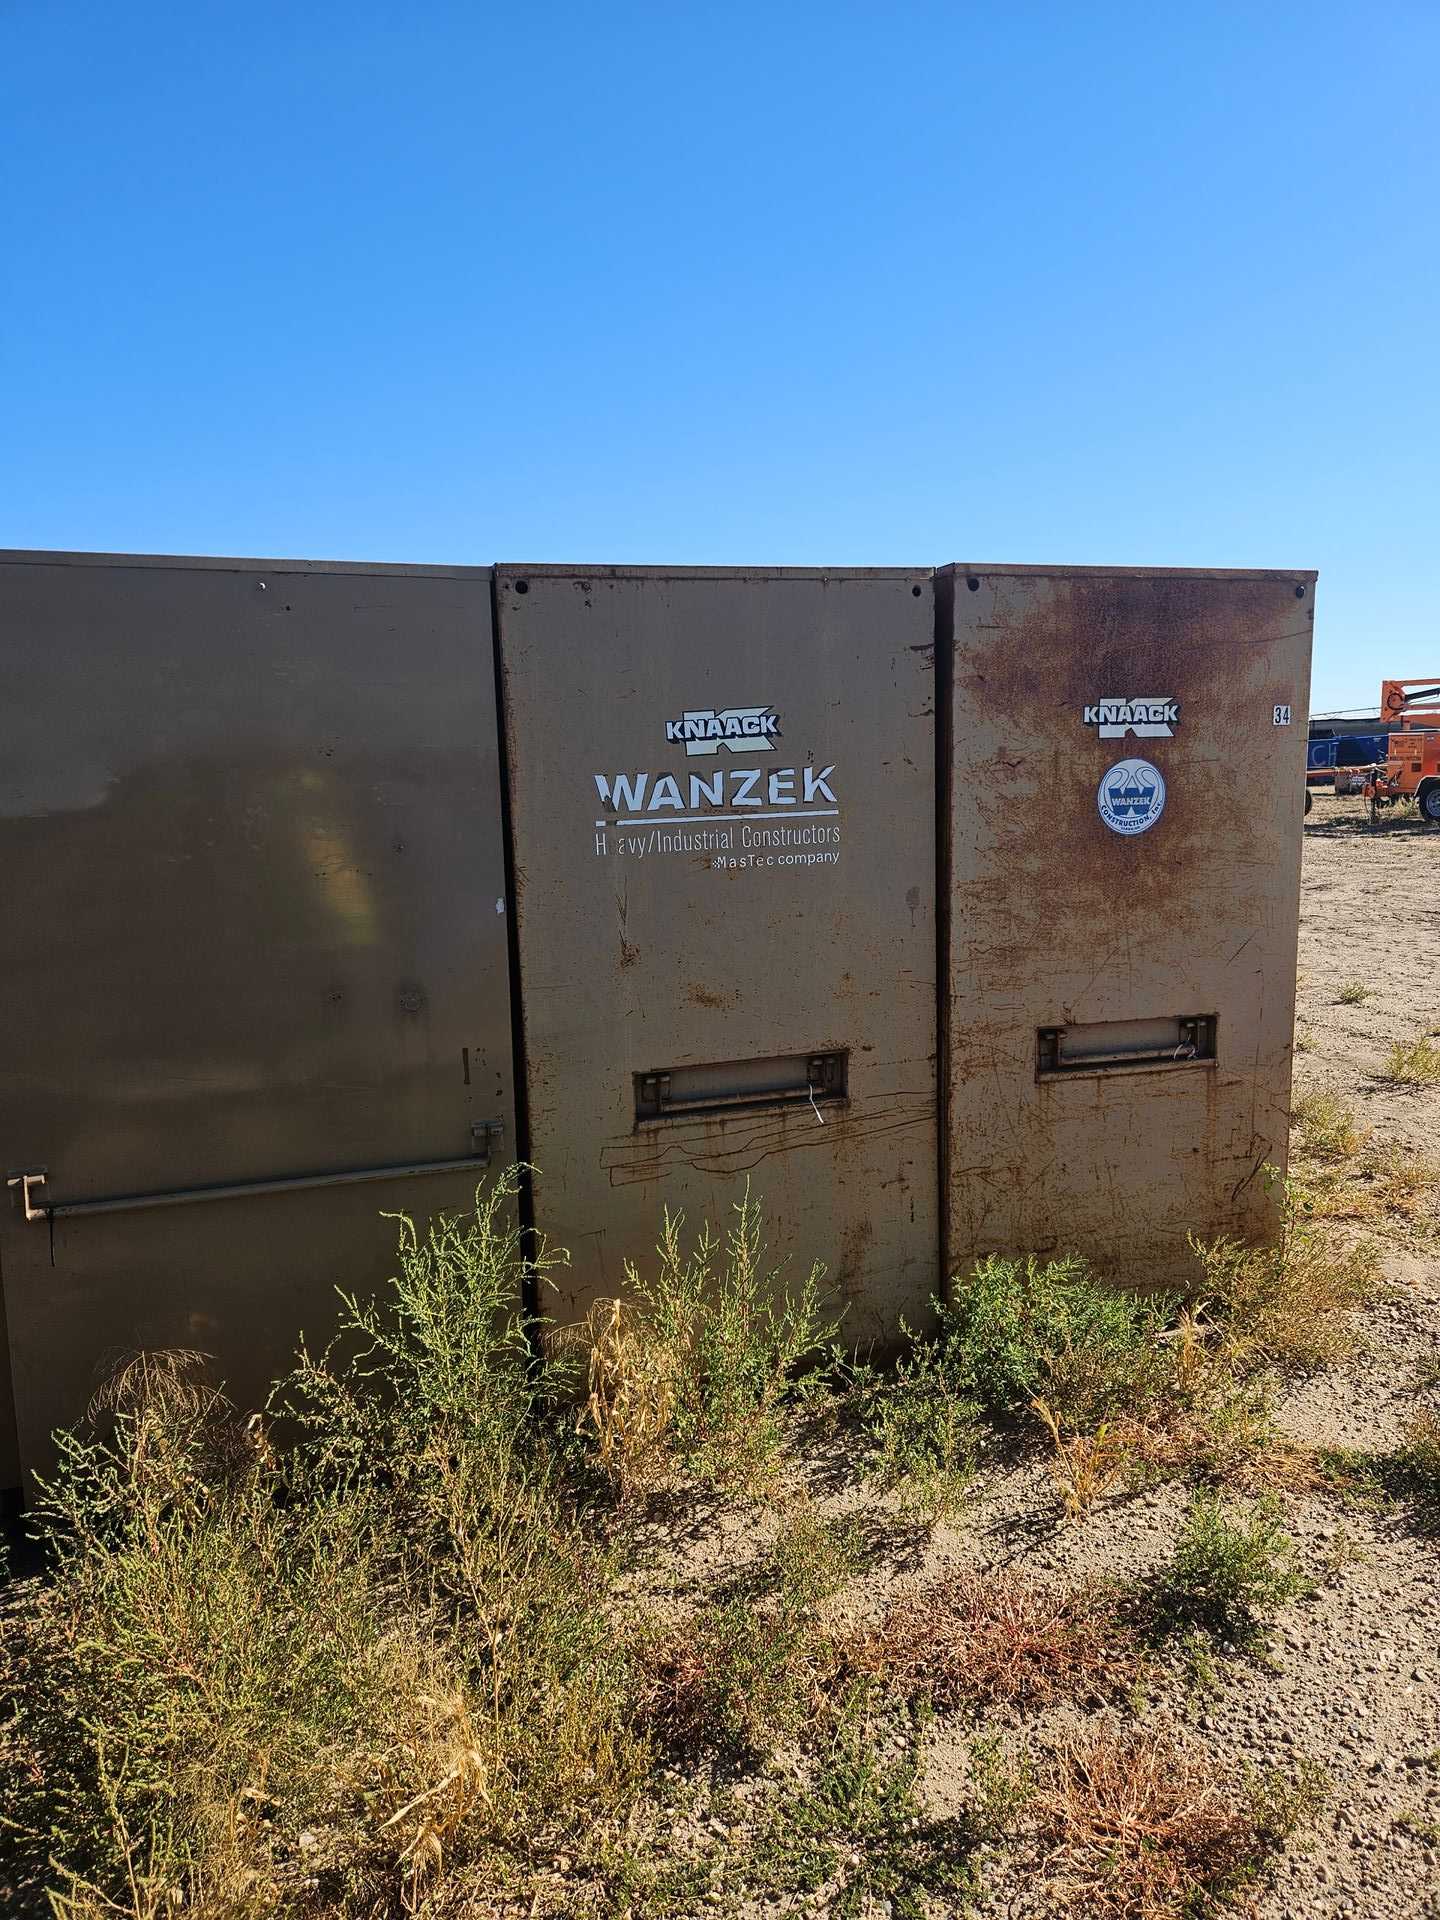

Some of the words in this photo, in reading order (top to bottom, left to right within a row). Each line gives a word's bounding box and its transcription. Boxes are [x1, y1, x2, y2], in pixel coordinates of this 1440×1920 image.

[1083, 704, 1179, 724] KNAACK
[1275, 706, 1289, 724] 34
[665, 714, 779, 741] KNAACK
[594, 764, 838, 812] WANZEK
[1111, 796, 1152, 806] WANZEK
[595, 826, 734, 859] Havy/Industrial
[741, 824, 841, 848] Constructors
[716, 854, 775, 869] MasTec
[777, 851, 840, 866] company
